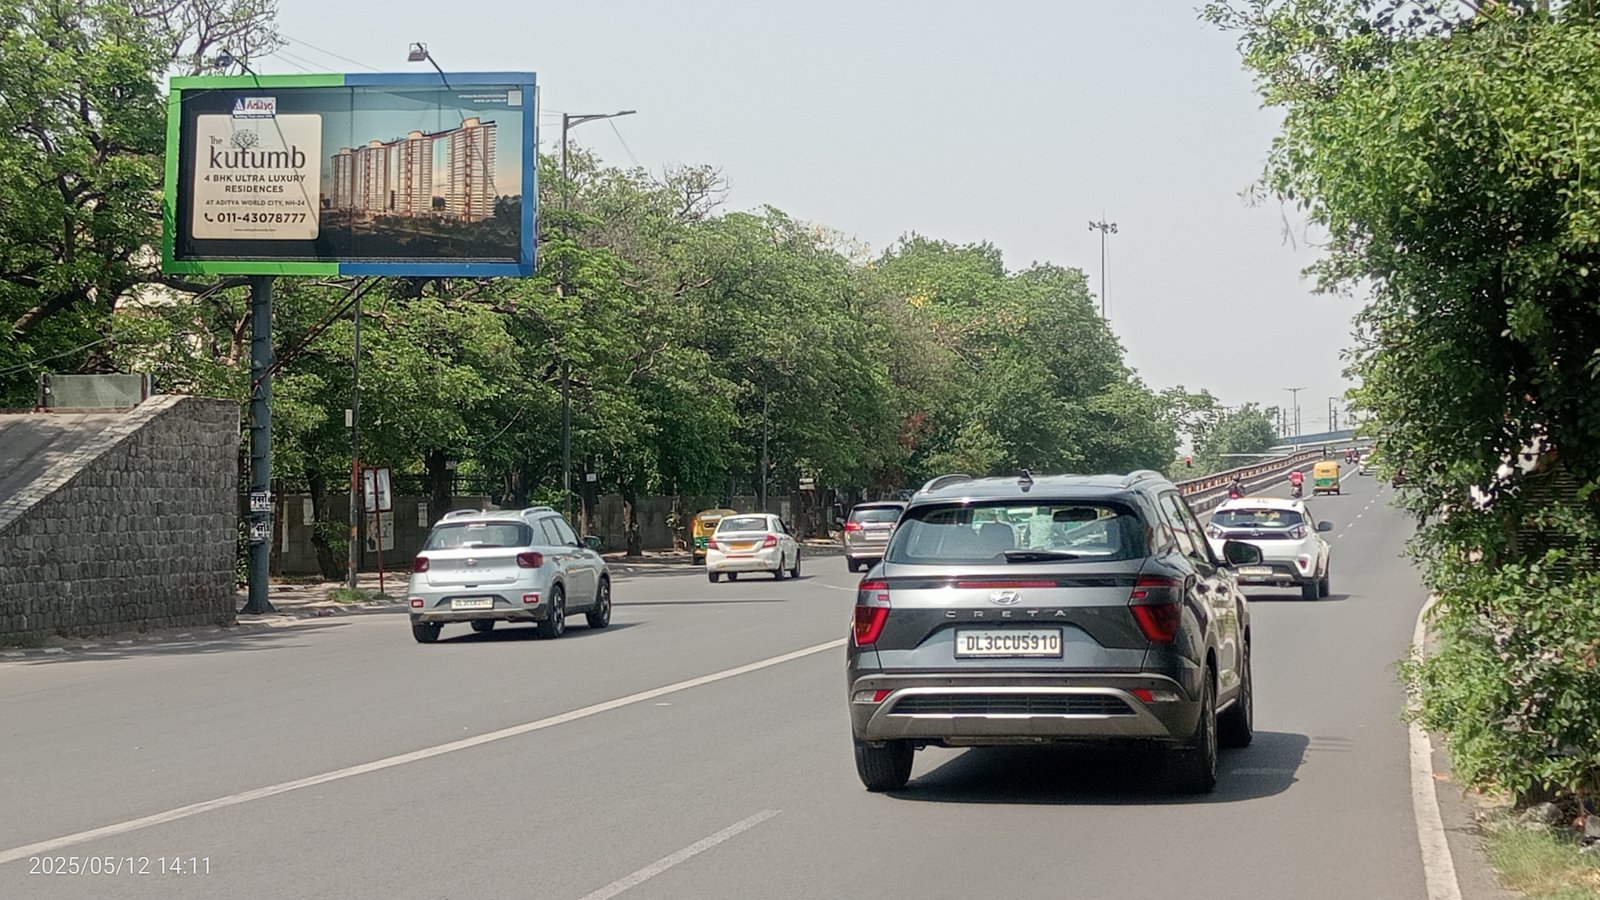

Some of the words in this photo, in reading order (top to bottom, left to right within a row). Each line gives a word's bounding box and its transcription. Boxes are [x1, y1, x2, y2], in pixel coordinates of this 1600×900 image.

[209, 135, 223, 145] The
[209, 145, 306, 169] kutumb
[204, 174, 211, 182] 4
[213, 174, 233, 182] BHK
[235, 174, 266, 182] ULTRA
[268, 174, 306, 182] LUXURY
[225, 185, 284, 193] RESIDENCES
[217, 212, 307, 223] 011-43078777
[945, 609, 1067, 618] CRETA
[966, 634, 1058, 651] DL3CCU5910
